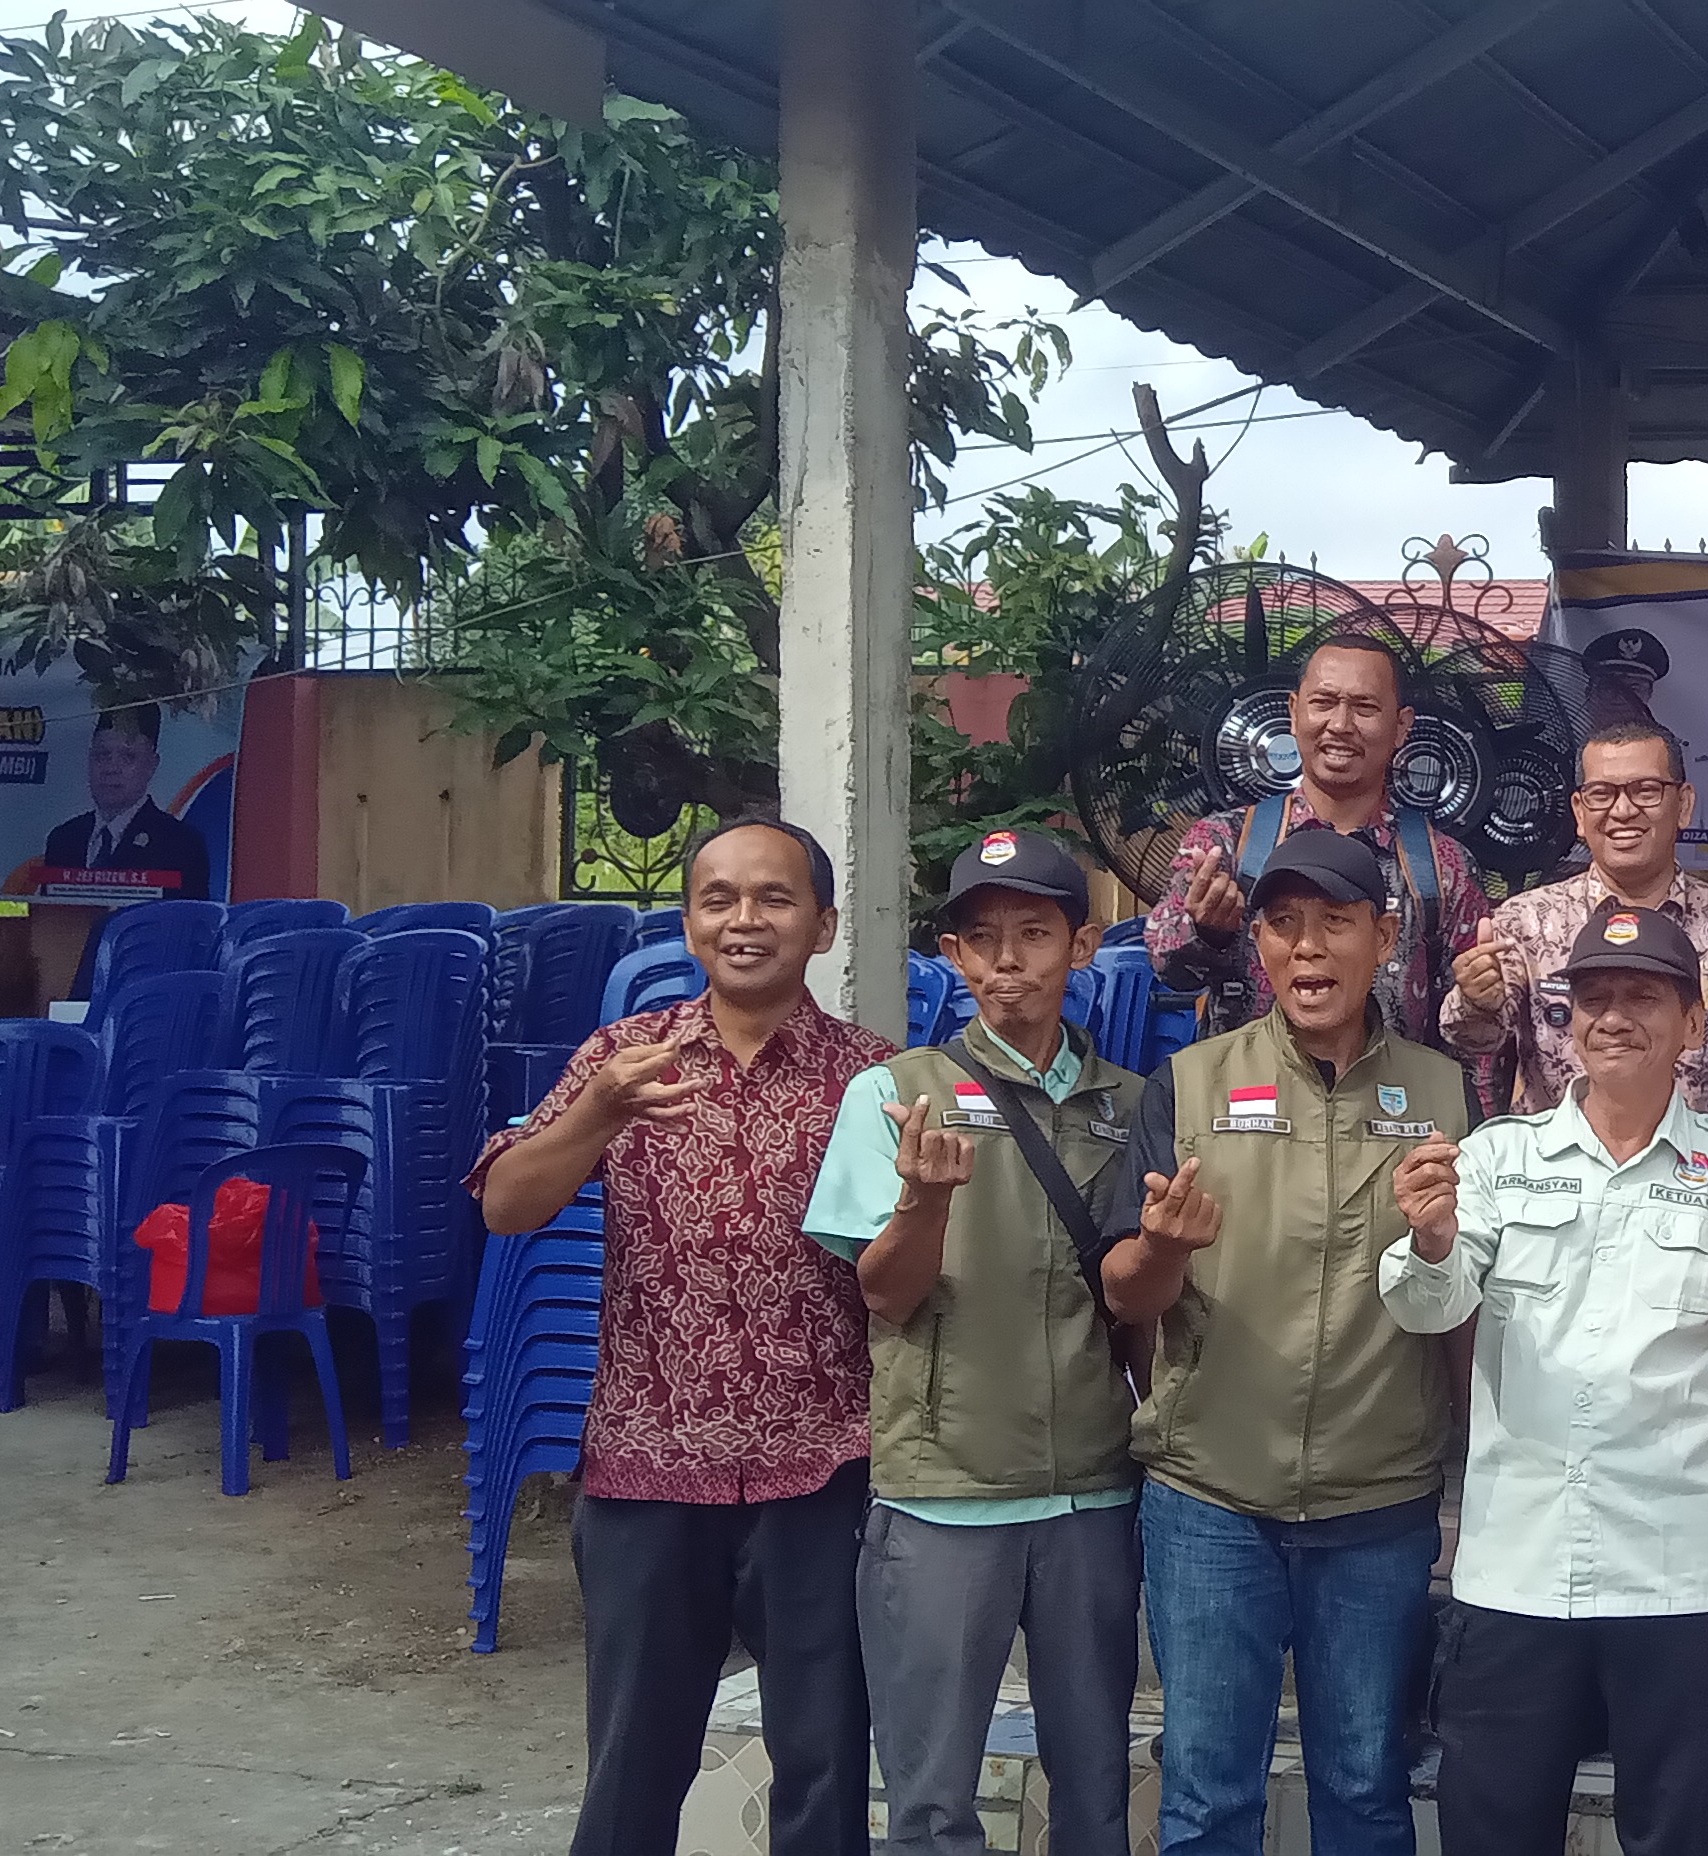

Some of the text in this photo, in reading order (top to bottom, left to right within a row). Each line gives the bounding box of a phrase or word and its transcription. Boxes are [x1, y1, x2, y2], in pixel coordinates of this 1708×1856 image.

[1682, 831, 1708, 842] DIZA
[1500, 1175, 1579, 1192] ARMANSYAH
[1655, 1188, 1701, 1205] KETUA
